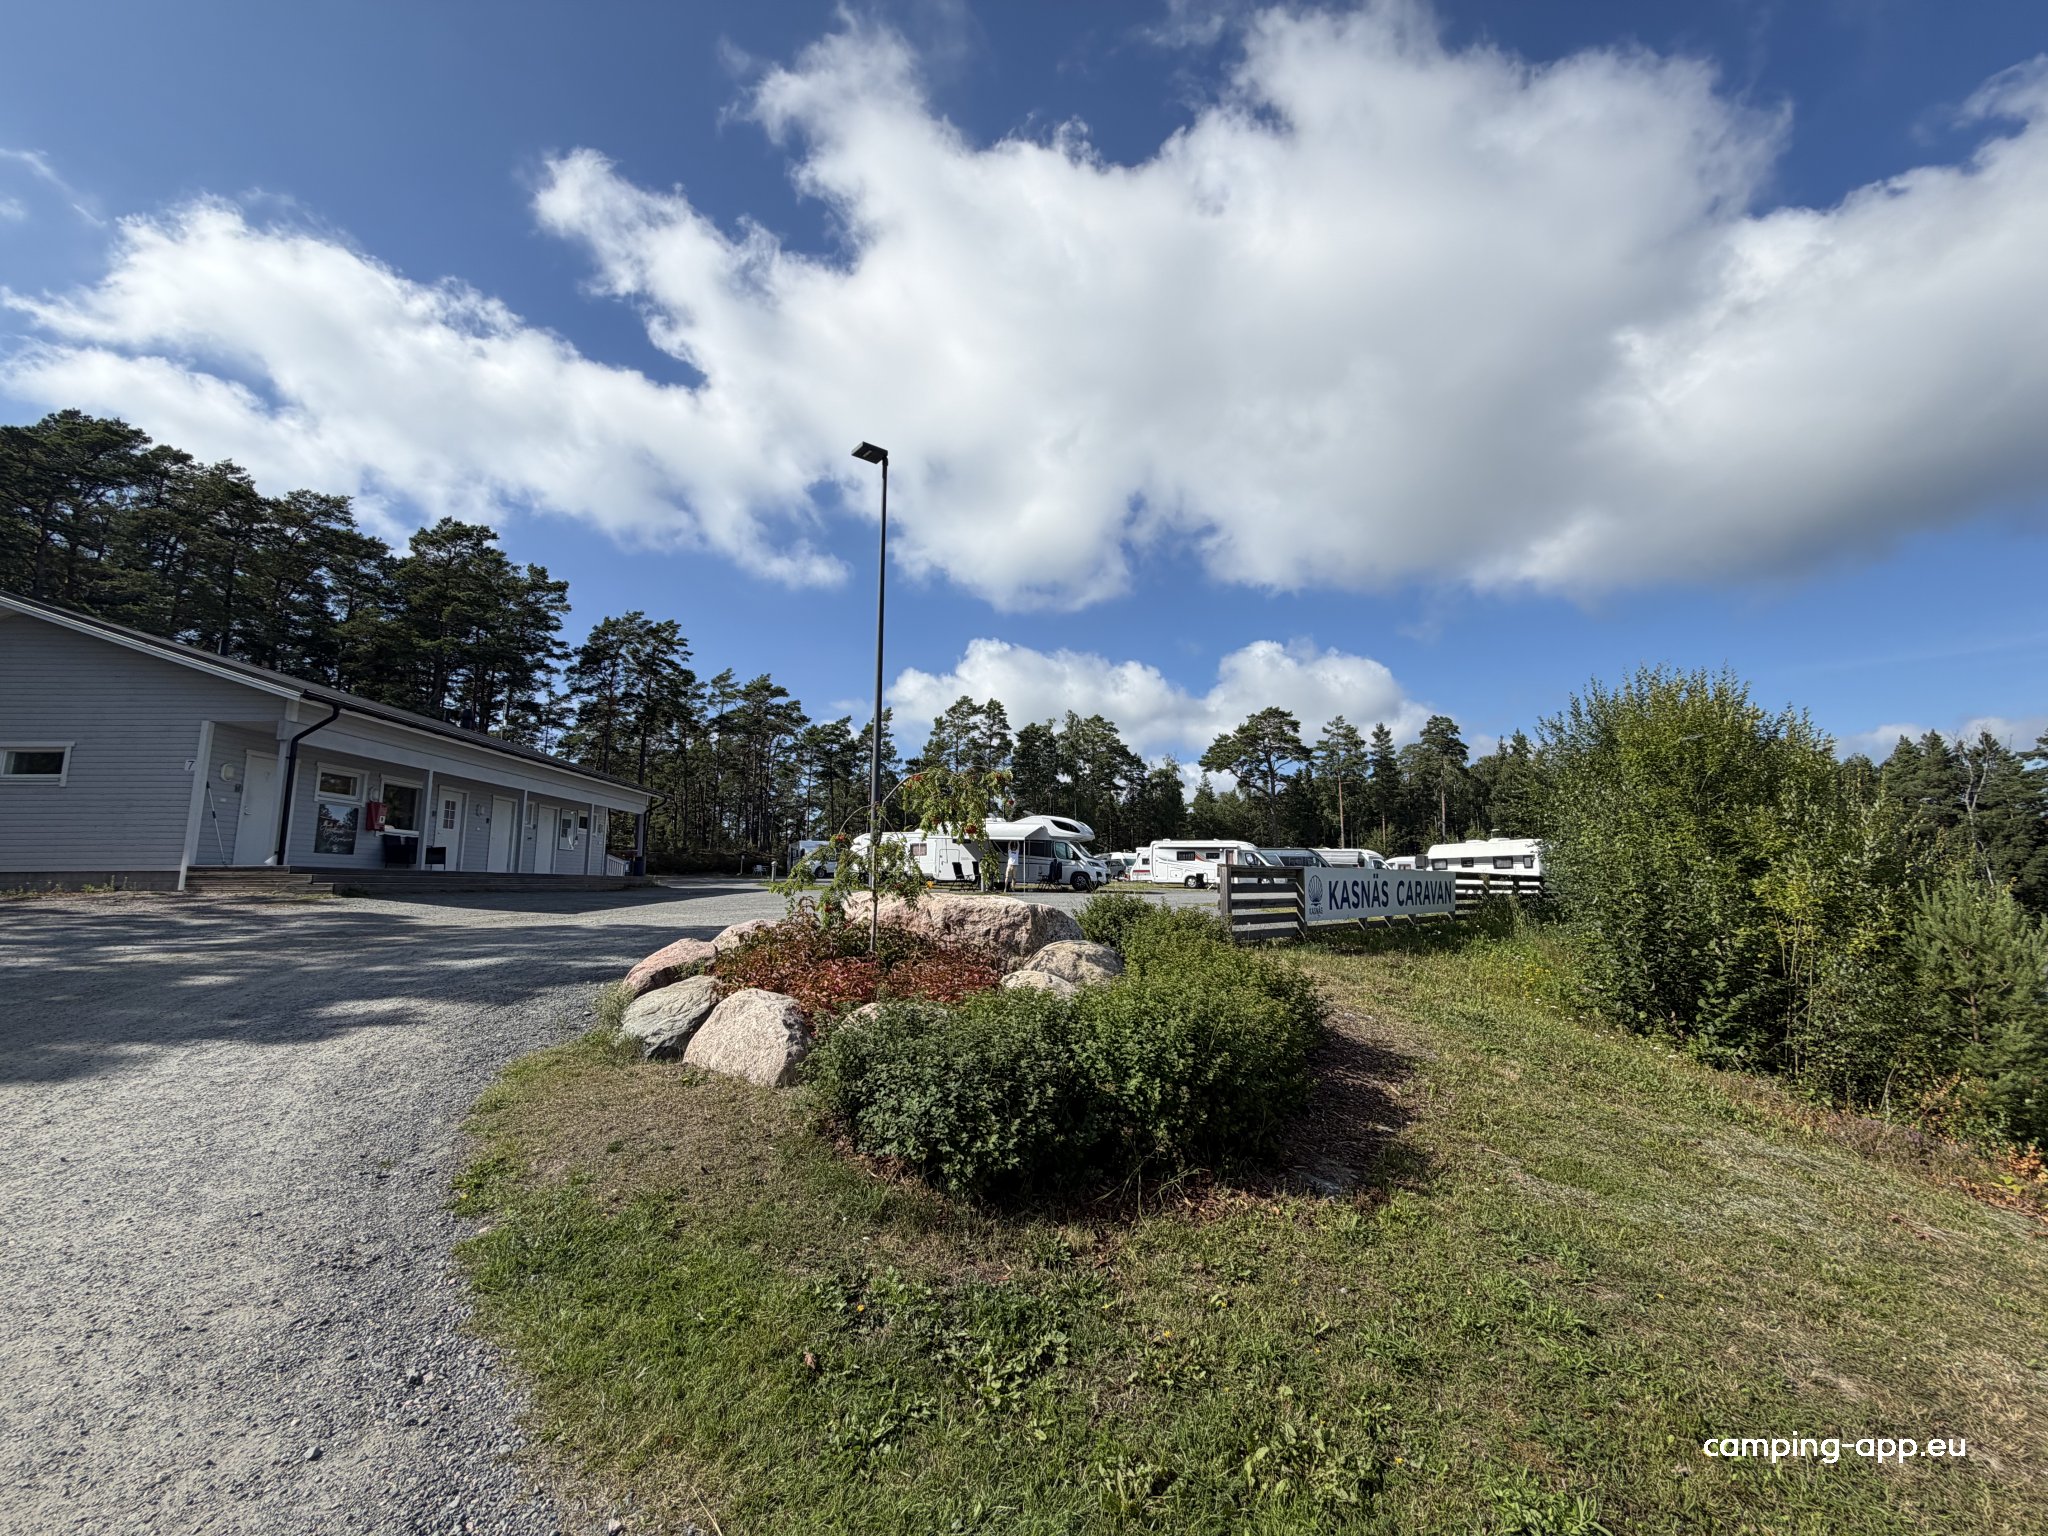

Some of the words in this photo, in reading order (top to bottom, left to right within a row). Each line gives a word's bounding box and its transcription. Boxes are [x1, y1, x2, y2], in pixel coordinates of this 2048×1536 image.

[188, 760, 195, 770] 7
[1328, 873, 1389, 910] KASNÄS
[1396, 880, 1452, 906] CARAVAN
